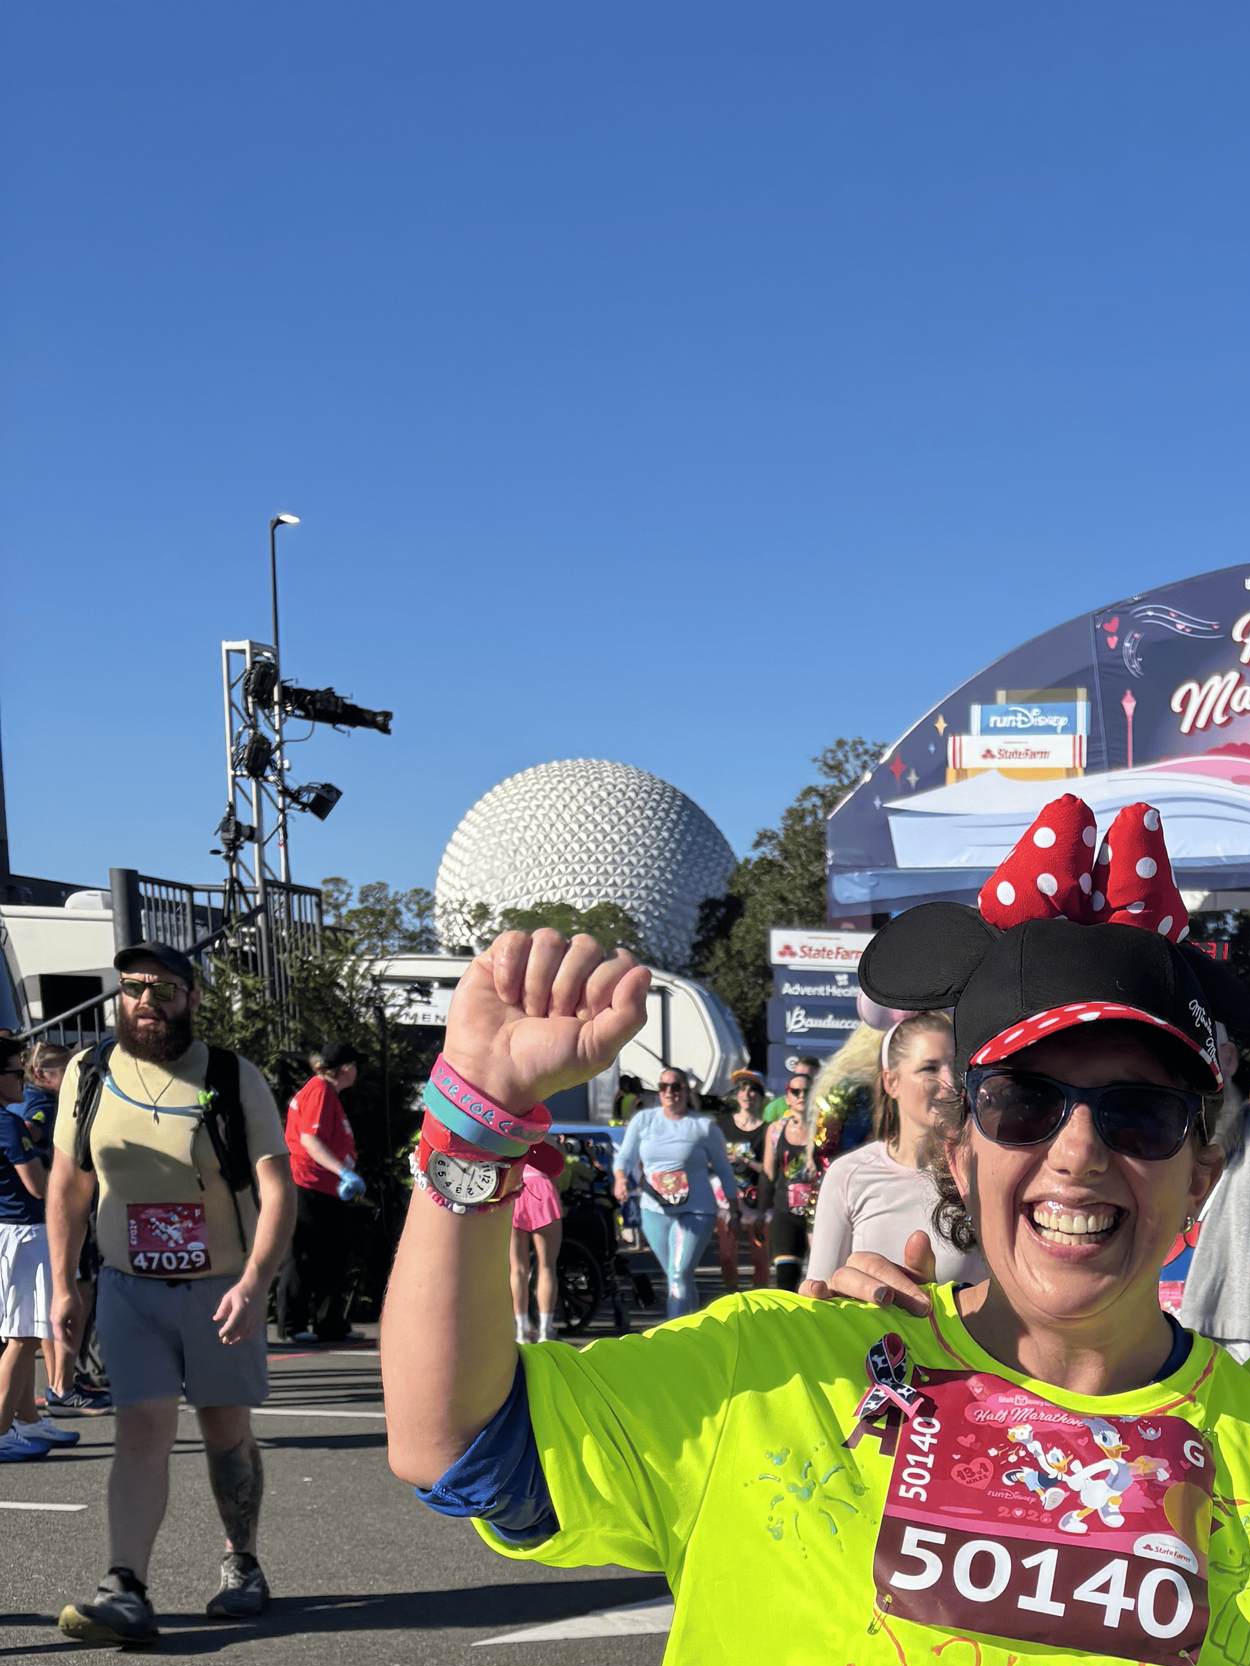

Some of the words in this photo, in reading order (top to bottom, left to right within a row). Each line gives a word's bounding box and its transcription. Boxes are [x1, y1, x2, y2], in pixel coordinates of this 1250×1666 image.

[989, 706, 1069, 734] runDisney
[133, 1251, 206, 1270] 47029
[973, 1408, 1008, 1423] Half
[1010, 1406, 1084, 1427] Marathon
[898, 1417, 941, 1503] 50140
[1183, 1440, 1205, 1468] G
[987, 1488, 1037, 1505] runDisney
[997, 1506, 1053, 1524] 2026
[889, 1525, 1195, 1640] 50140
